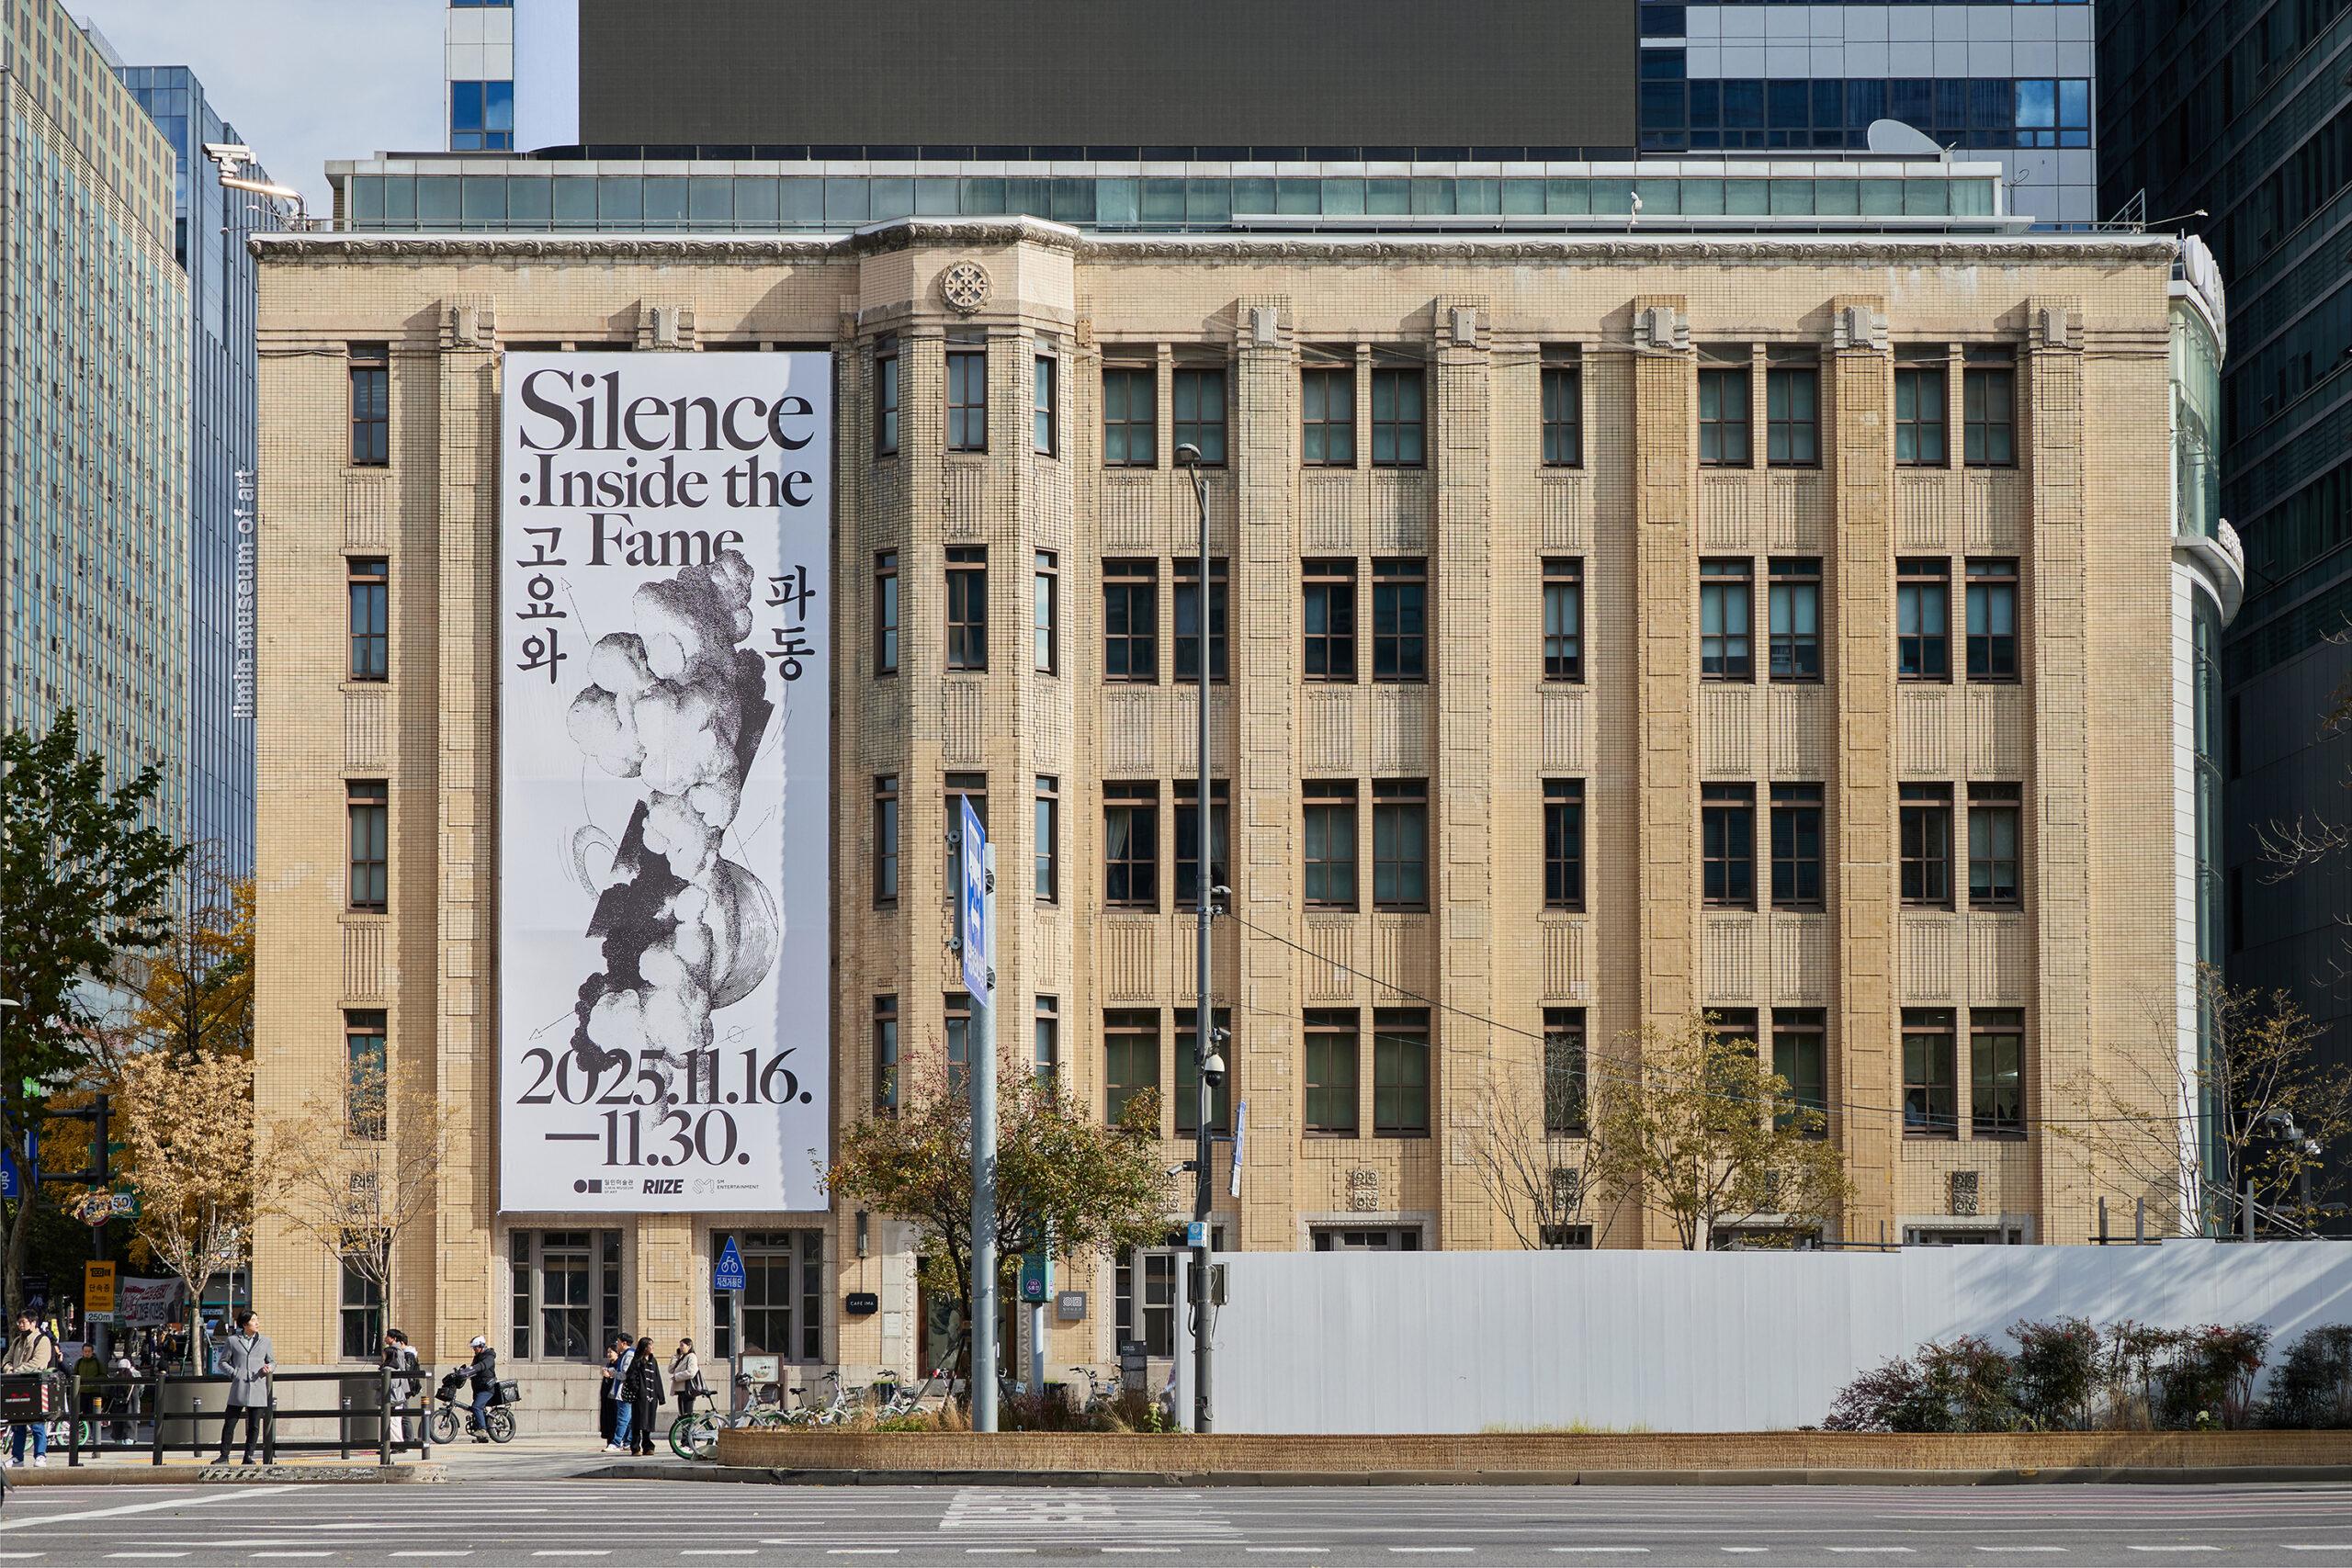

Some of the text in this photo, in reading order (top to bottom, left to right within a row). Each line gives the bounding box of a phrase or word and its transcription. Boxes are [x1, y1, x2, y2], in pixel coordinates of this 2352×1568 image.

[520, 369, 815, 451] Silence
[520, 454, 814, 508] :Inside the
[233, 469, 254, 718] ilmin museum of art
[516, 527, 567, 684] 고요와
[765, 565, 816, 682] 파동
[516, 1047, 812, 1105] 2025.11.16.
[642, 1179, 684, 1194] RIIZE
[89, 1284, 109, 1292] 단속중
[717, 1277, 742, 1287] 자전거횡단
